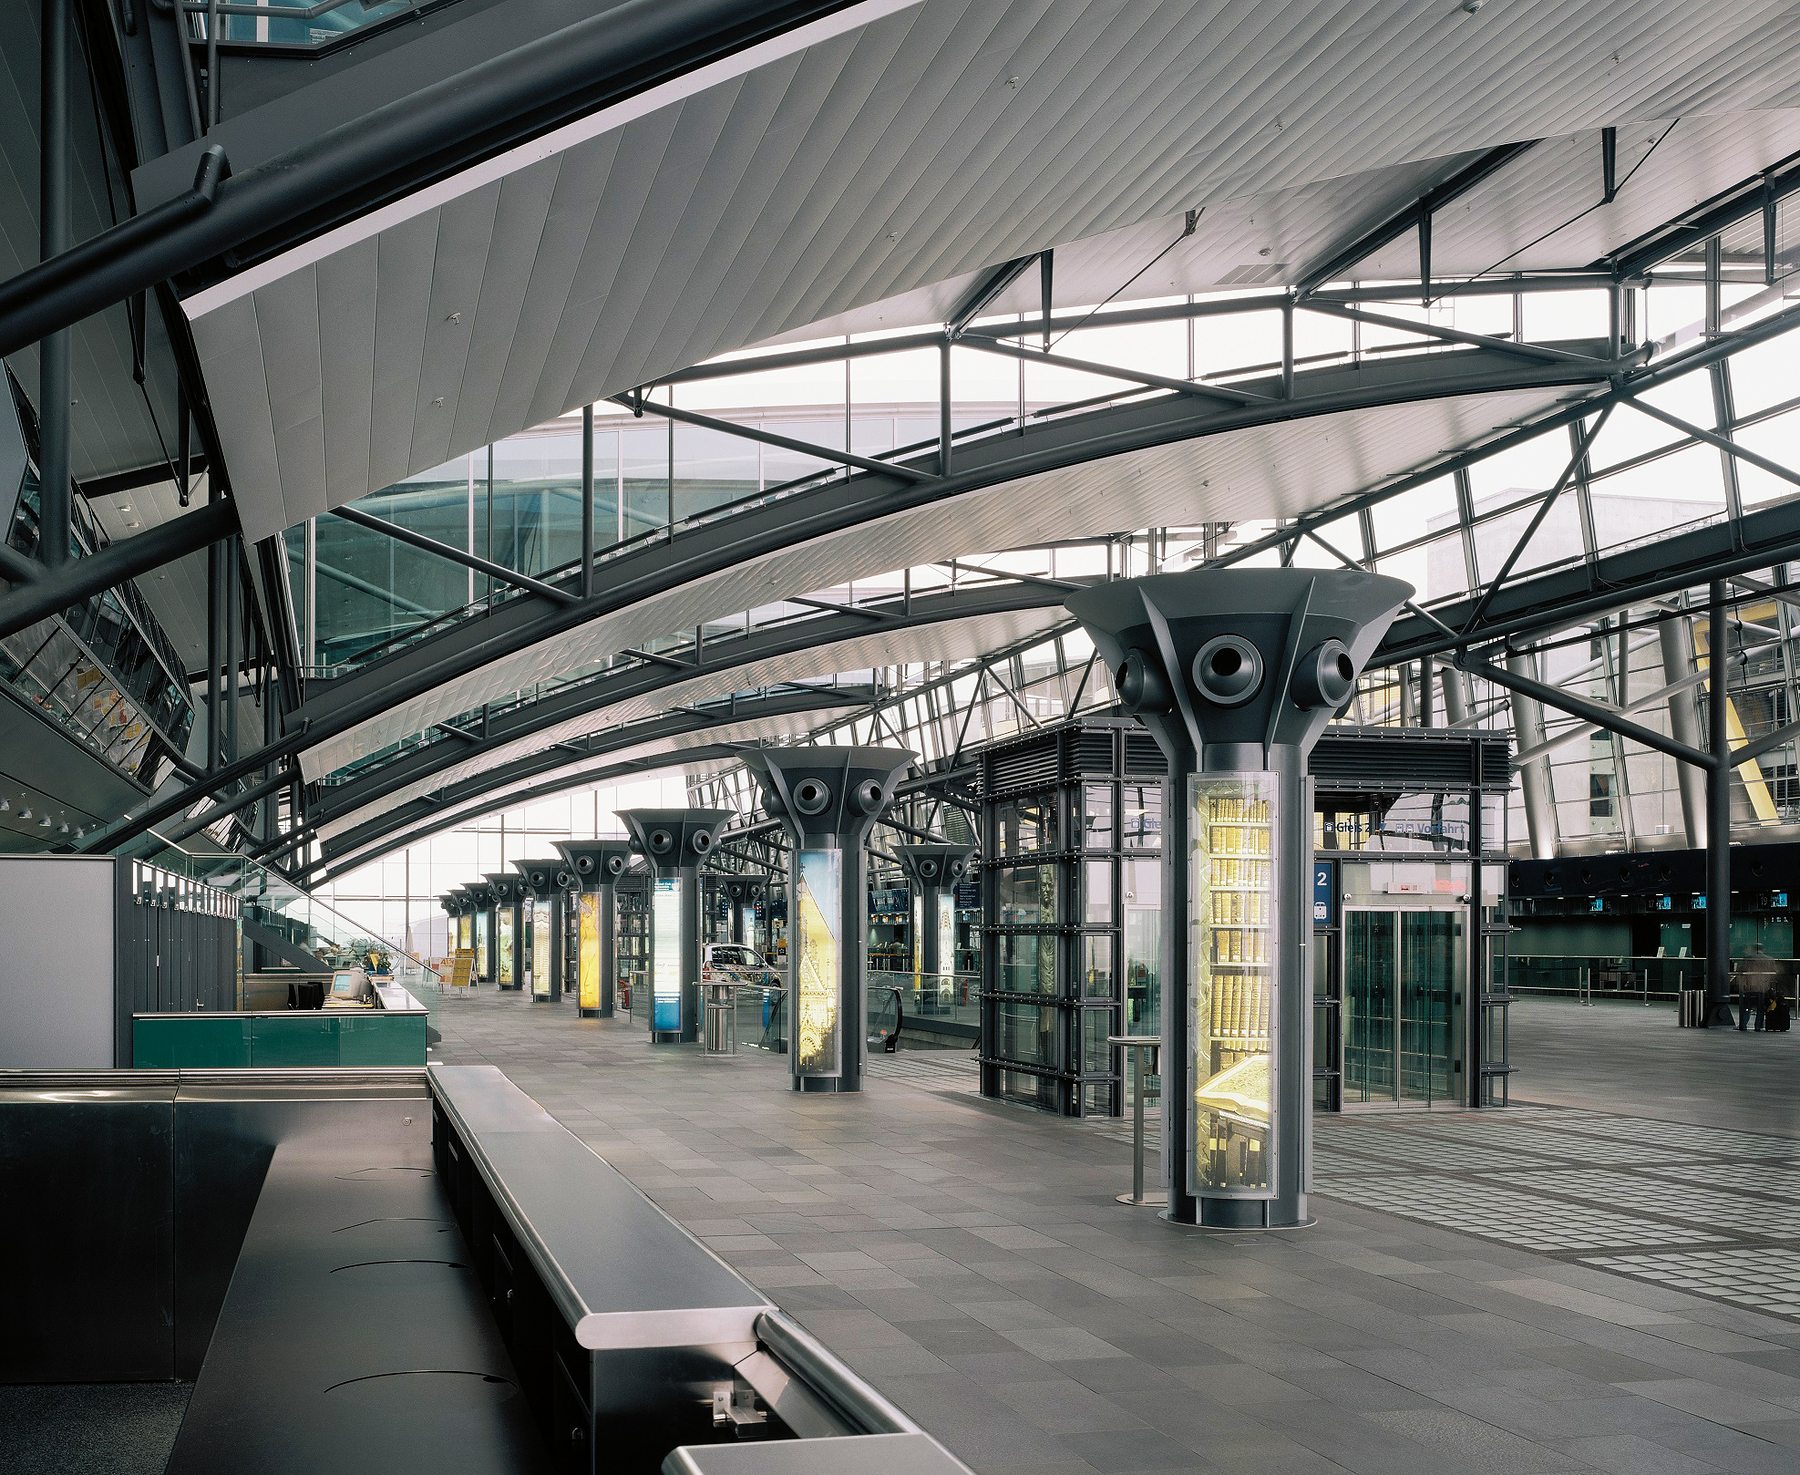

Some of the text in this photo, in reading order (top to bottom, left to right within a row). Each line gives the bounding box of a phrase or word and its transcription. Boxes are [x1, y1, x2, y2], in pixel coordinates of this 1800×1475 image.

[1336, 822, 1363, 832] Gleis
[1417, 823, 1465, 834] Vofahrt
[1317, 872, 1327, 886] 2
